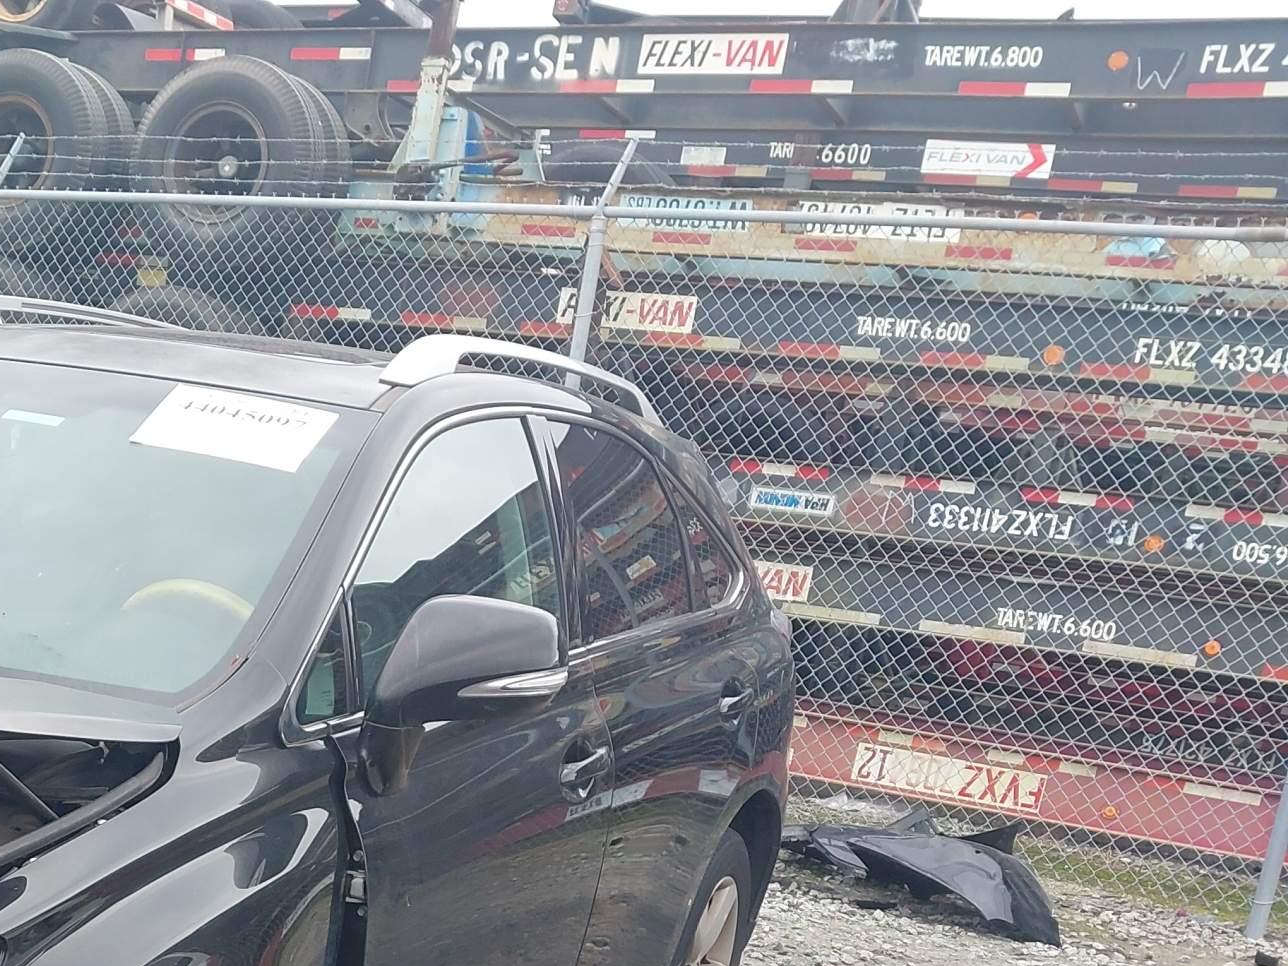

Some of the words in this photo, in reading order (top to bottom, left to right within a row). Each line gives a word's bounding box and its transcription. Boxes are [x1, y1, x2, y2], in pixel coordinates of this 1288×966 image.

[643, 39, 786, 71] FLEXI-VAN
[1199, 44, 1276, 73] FLXZ
[926, 150, 982, 164] FLEXI
[987, 153, 1027, 166] VAN
[1134, 338, 1197, 368] FLXZ
